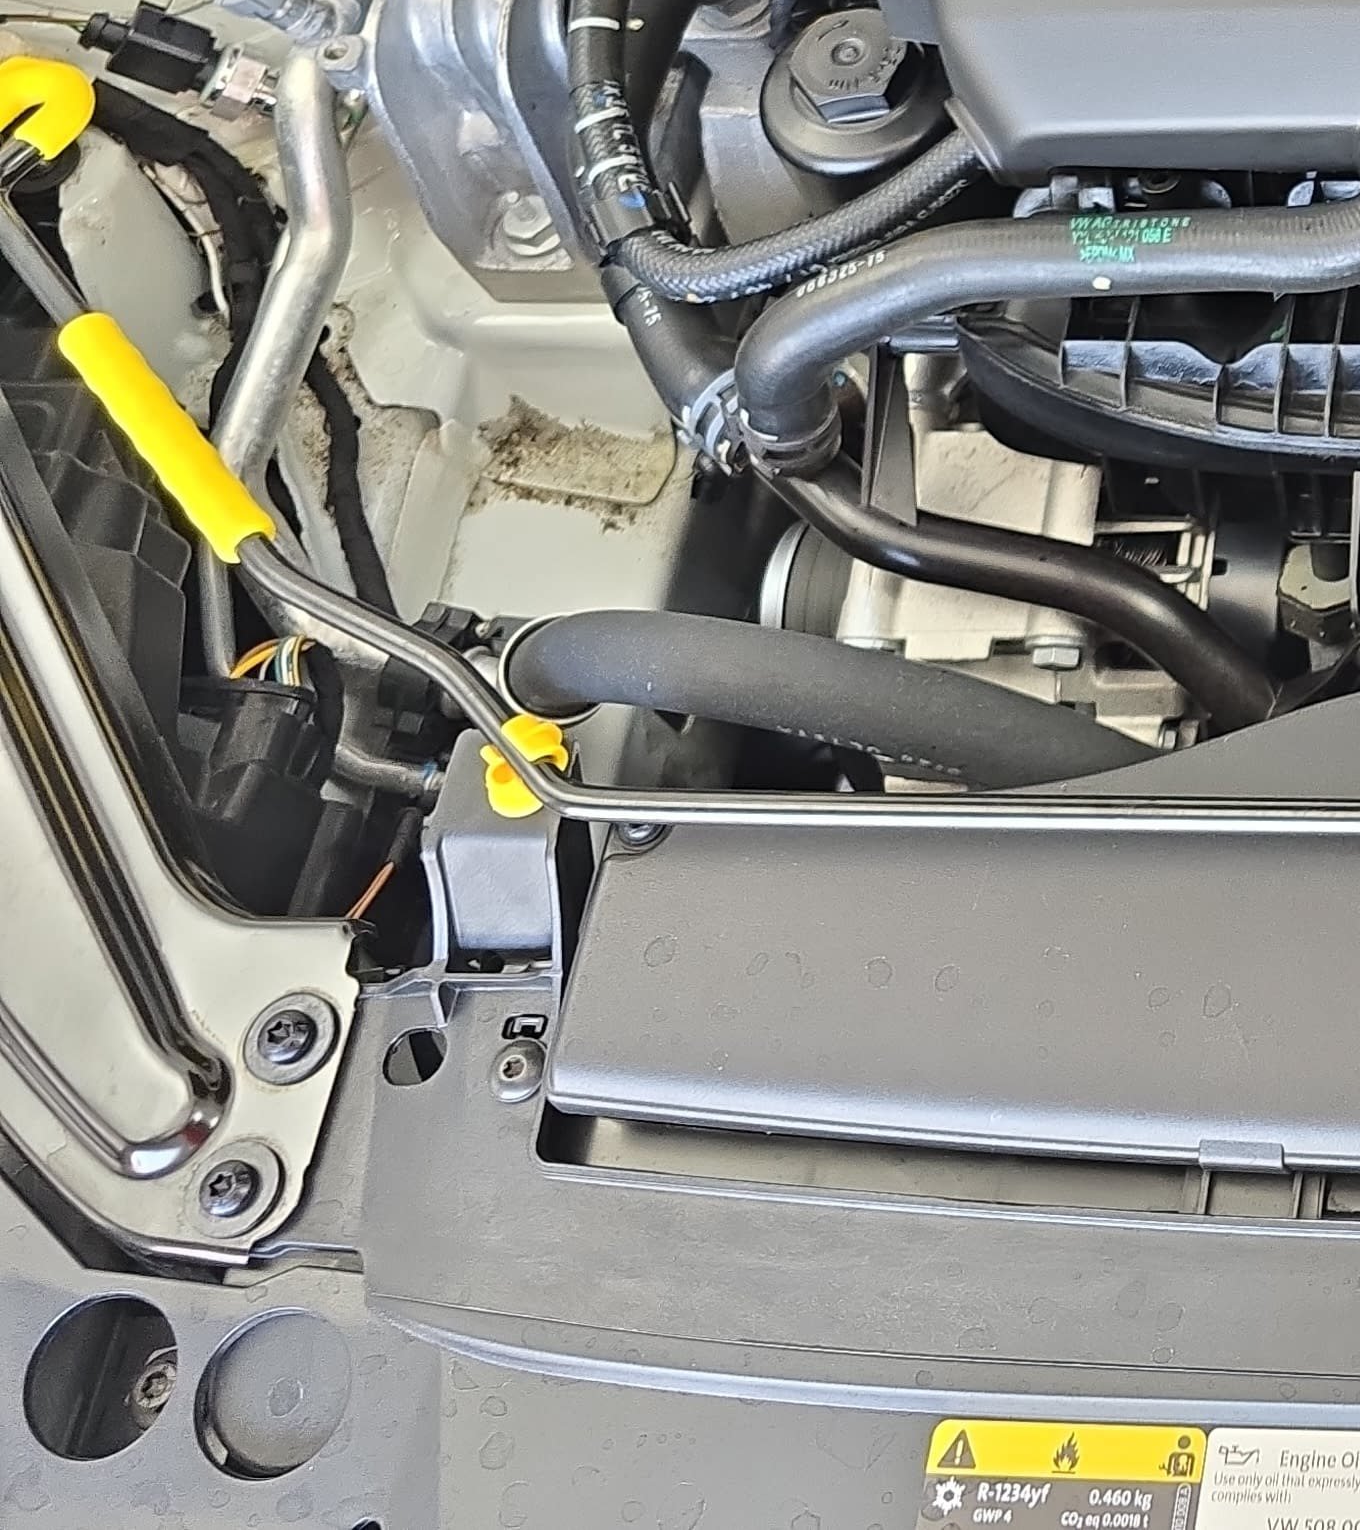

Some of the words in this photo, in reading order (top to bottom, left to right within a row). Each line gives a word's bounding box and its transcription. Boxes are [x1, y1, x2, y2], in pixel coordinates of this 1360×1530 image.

[1279, 1449, 1337, 1472] Engine
[1214, 1471, 1236, 1486] Use
[1237, 1472, 1263, 1490] only
[1264, 1472, 1279, 1487] oil
[1281, 1473, 1305, 1488] that
[977, 1483, 1051, 1508] R-1234yf
[1089, 1489, 1132, 1507] 0.460
[1134, 1492, 1153, 1512] kg
[1211, 1488, 1264, 1506] complies
[1265, 1489, 1293, 1504] with
[972, 1509, 1002, 1524] GWP
[1003, 1510, 1013, 1524] 4
[1085, 1515, 1100, 1530] eq
[1142, 1515, 1149, 1528] t
[1267, 1518, 1300, 1530] VW
